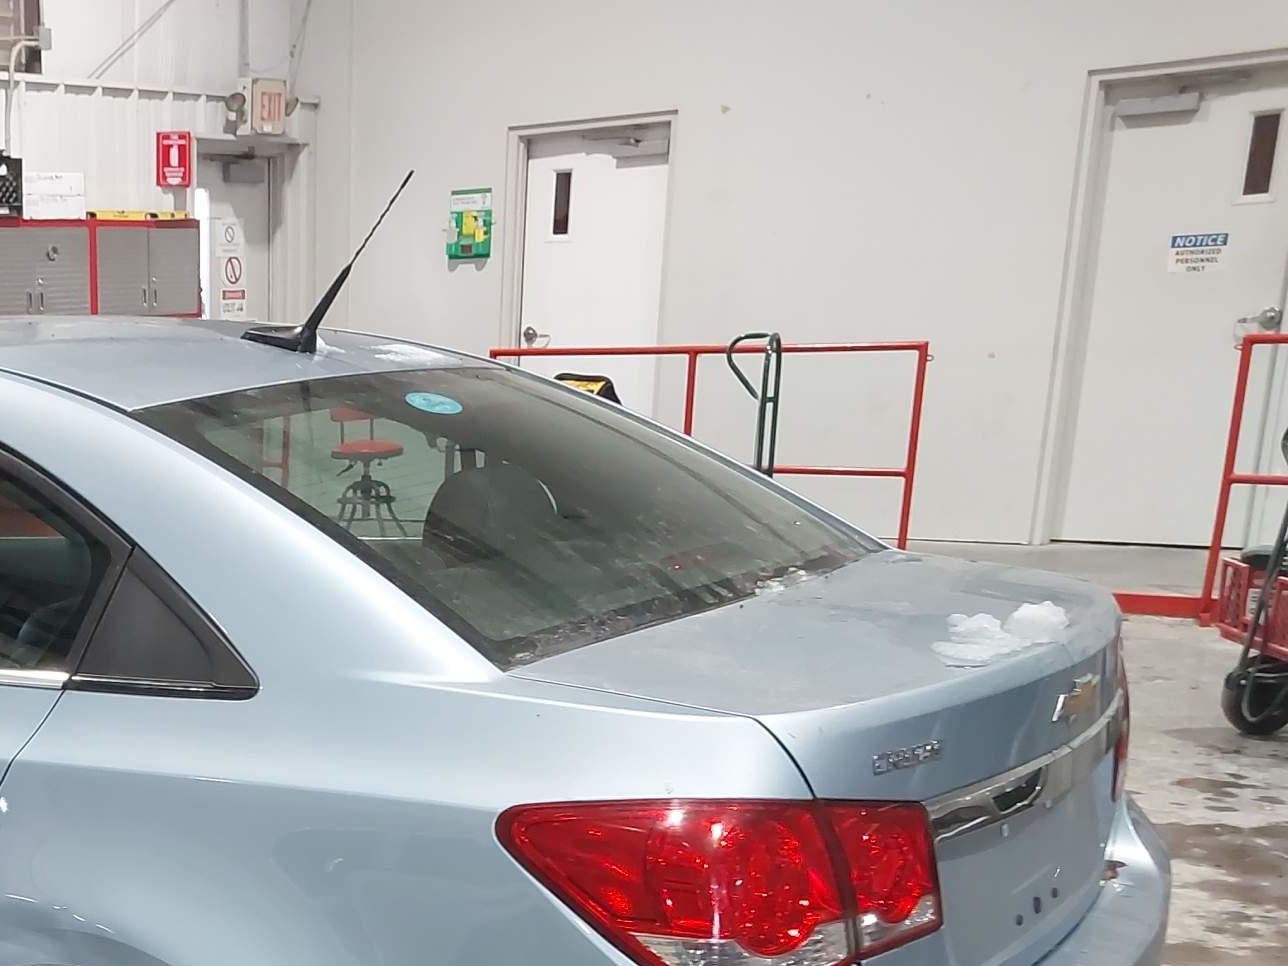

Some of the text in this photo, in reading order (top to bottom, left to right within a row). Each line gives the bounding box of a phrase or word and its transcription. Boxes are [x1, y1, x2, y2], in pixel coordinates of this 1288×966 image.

[260, 92, 282, 121] EXIT
[1174, 234, 1226, 247] NOTICE
[1175, 248, 1222, 256] AUTHORIZED
